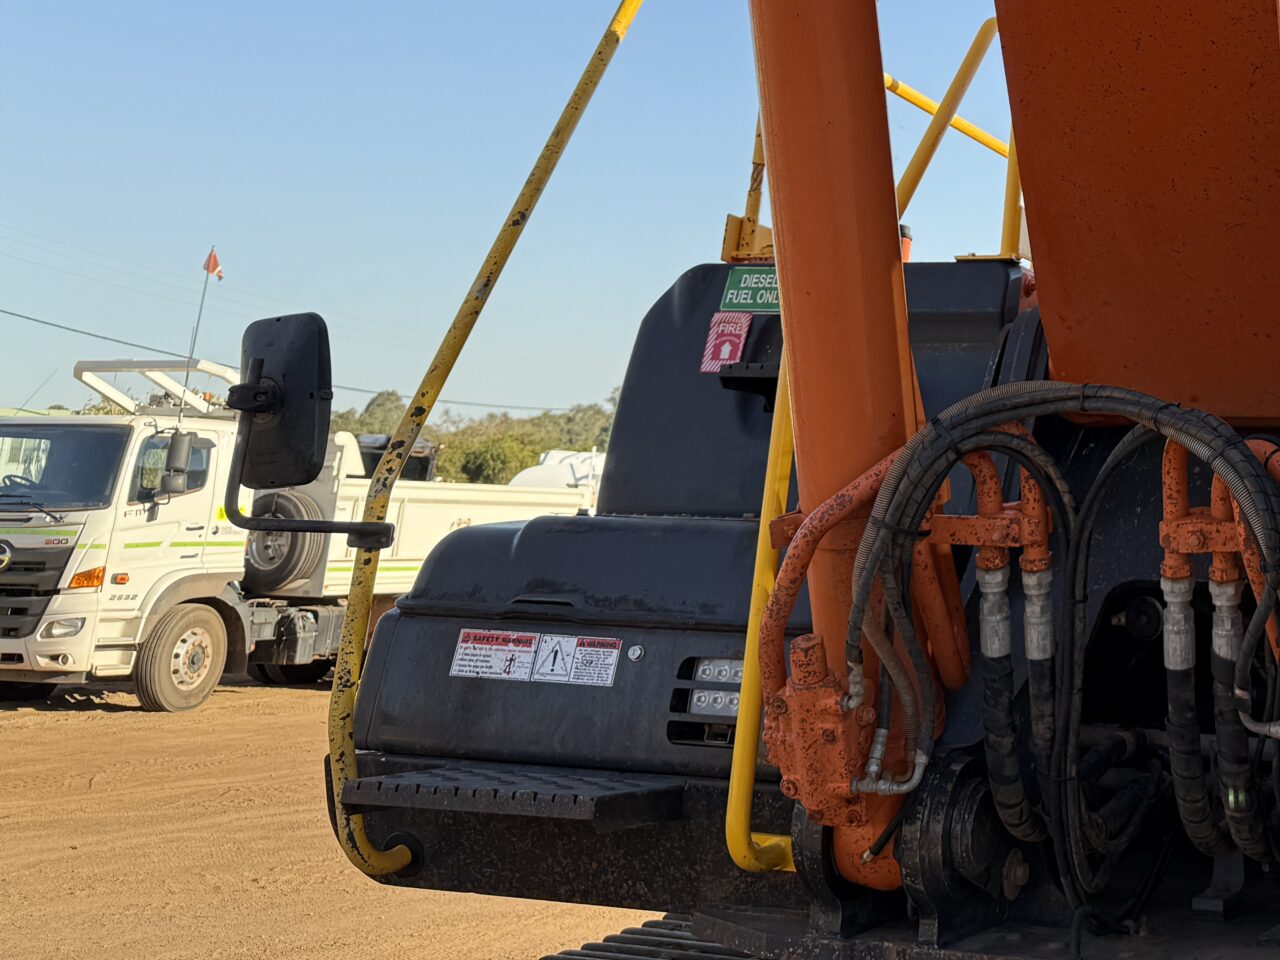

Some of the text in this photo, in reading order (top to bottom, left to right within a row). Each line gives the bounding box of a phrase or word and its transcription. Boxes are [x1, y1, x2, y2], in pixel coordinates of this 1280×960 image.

[741, 274, 779, 288] DIESEL
[726, 290, 779, 303] FUEL ONL
[719, 323, 743, 334] FIRE
[473, 635, 533, 645] SAFETY WARNING
[587, 640, 617, 649] WARNING
